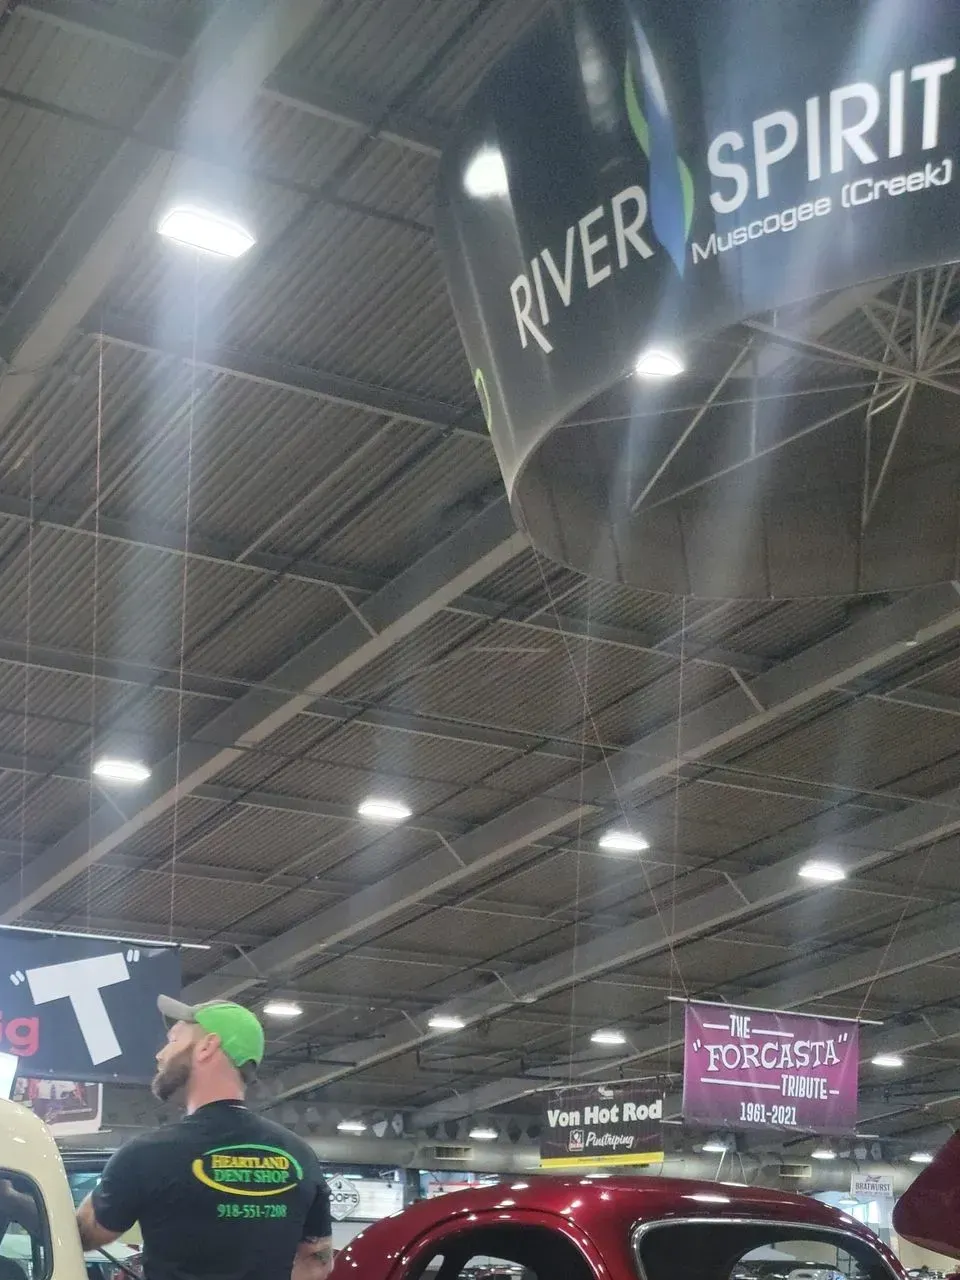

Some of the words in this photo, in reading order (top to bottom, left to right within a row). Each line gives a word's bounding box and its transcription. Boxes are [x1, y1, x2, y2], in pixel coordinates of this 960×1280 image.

[510, 184, 654, 355] RIVER
[707, 56, 957, 215] SPIRIT
[691, 195, 833, 265] Muscogee
[841, 158, 954, 209] (Creek)
[729, 1014, 751, 1039] THE
[781, 1074, 828, 1100] TRIBUTE
[547, 1109, 580, 1128] Von
[584, 1103, 620, 1125] Hot
[622, 1099, 663, 1121] Rod
[740, 1101, 797, 1126] 1961-2021
[585, 1131, 635, 1150] Pinstriping
[211, 1154, 290, 1170] HEARTLAND
[213, 1168, 252, 1183] DENT
[253, 1169, 290, 1184] SHOP
[855, 1181, 891, 1193] BRATWURST
